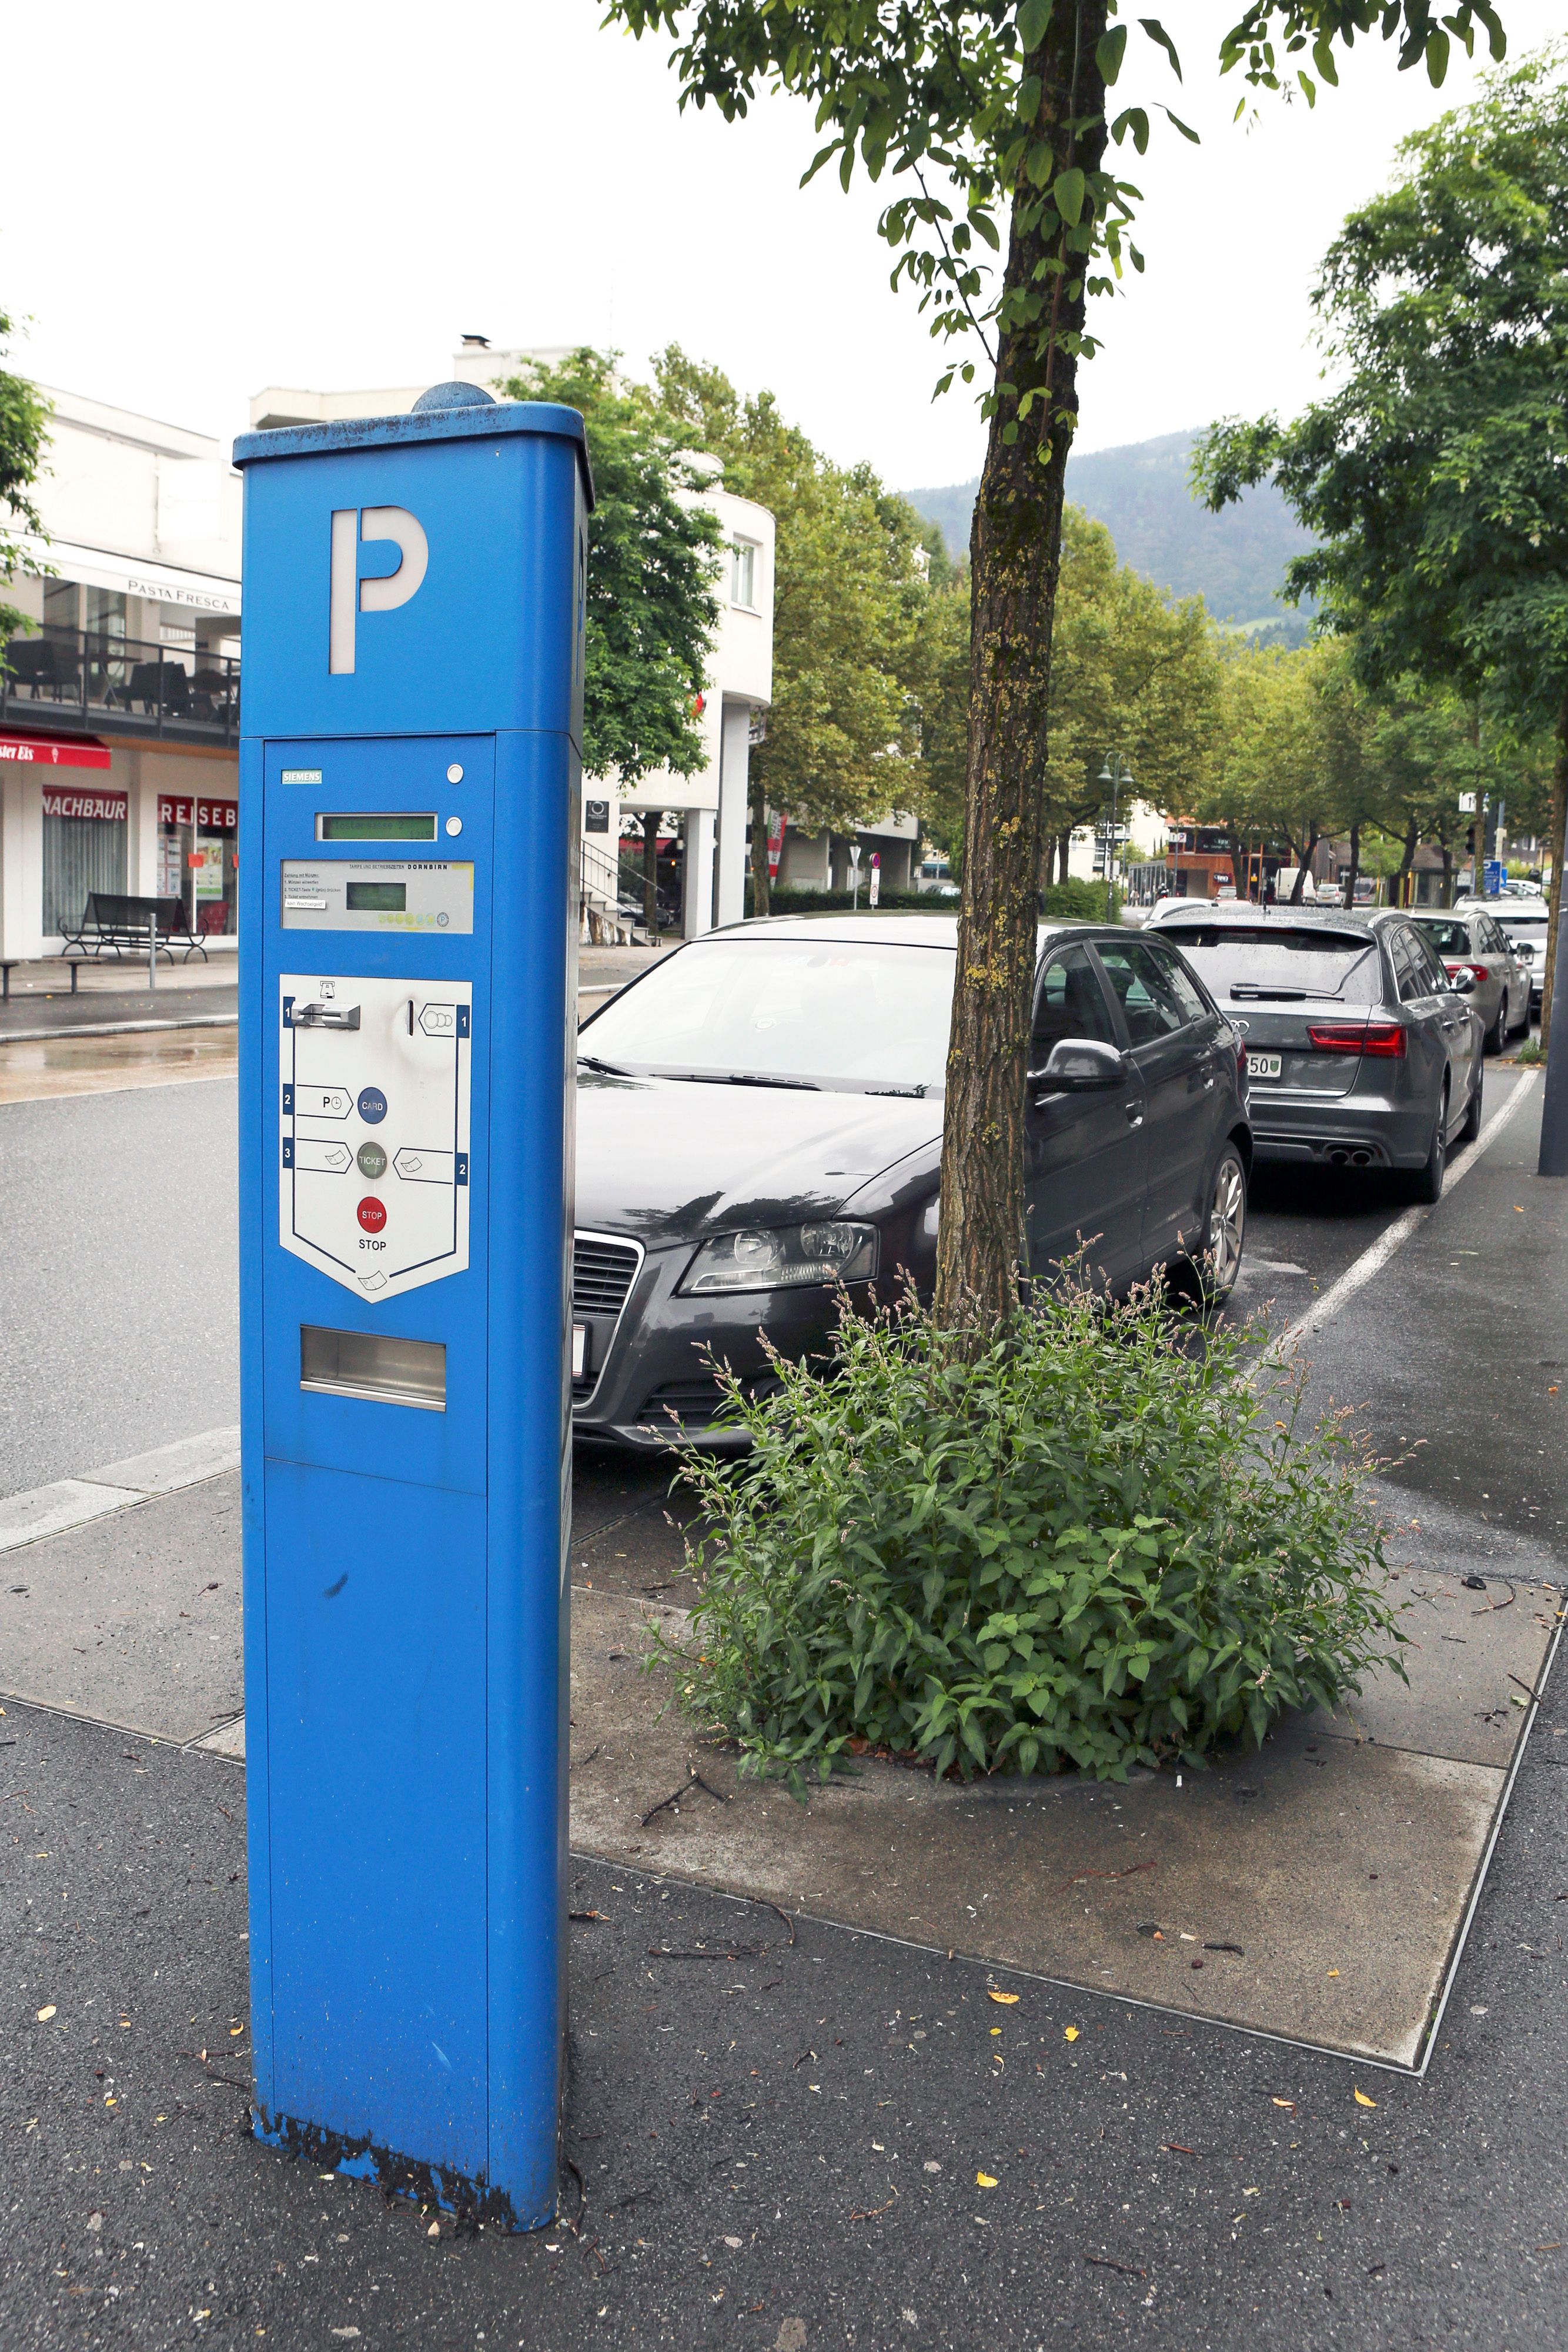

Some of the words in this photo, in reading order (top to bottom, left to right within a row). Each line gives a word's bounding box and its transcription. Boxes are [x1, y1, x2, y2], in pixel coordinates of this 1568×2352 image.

[329, 505, 429, 674] P
[176, 590, 230, 610] FRESCA
[17, 745, 34, 760] Eis
[283, 773, 320, 781] SIEMENS
[42, 796, 127, 820] NACHBAUR
[285, 1007, 290, 1018] 1
[461, 1016, 466, 1027] 1
[1246, 1057, 1268, 1074] 50
[285, 1094, 290, 1105] 2
[323, 1097, 330, 1108] P
[362, 1101, 383, 1111] CARD
[285, 1148, 290, 1158] 3
[359, 1155, 386, 1166] TICKET
[459, 1164, 466, 1175] 2
[362, 1210, 382, 1220] STOP
[359, 1239, 386, 1251] STOP
